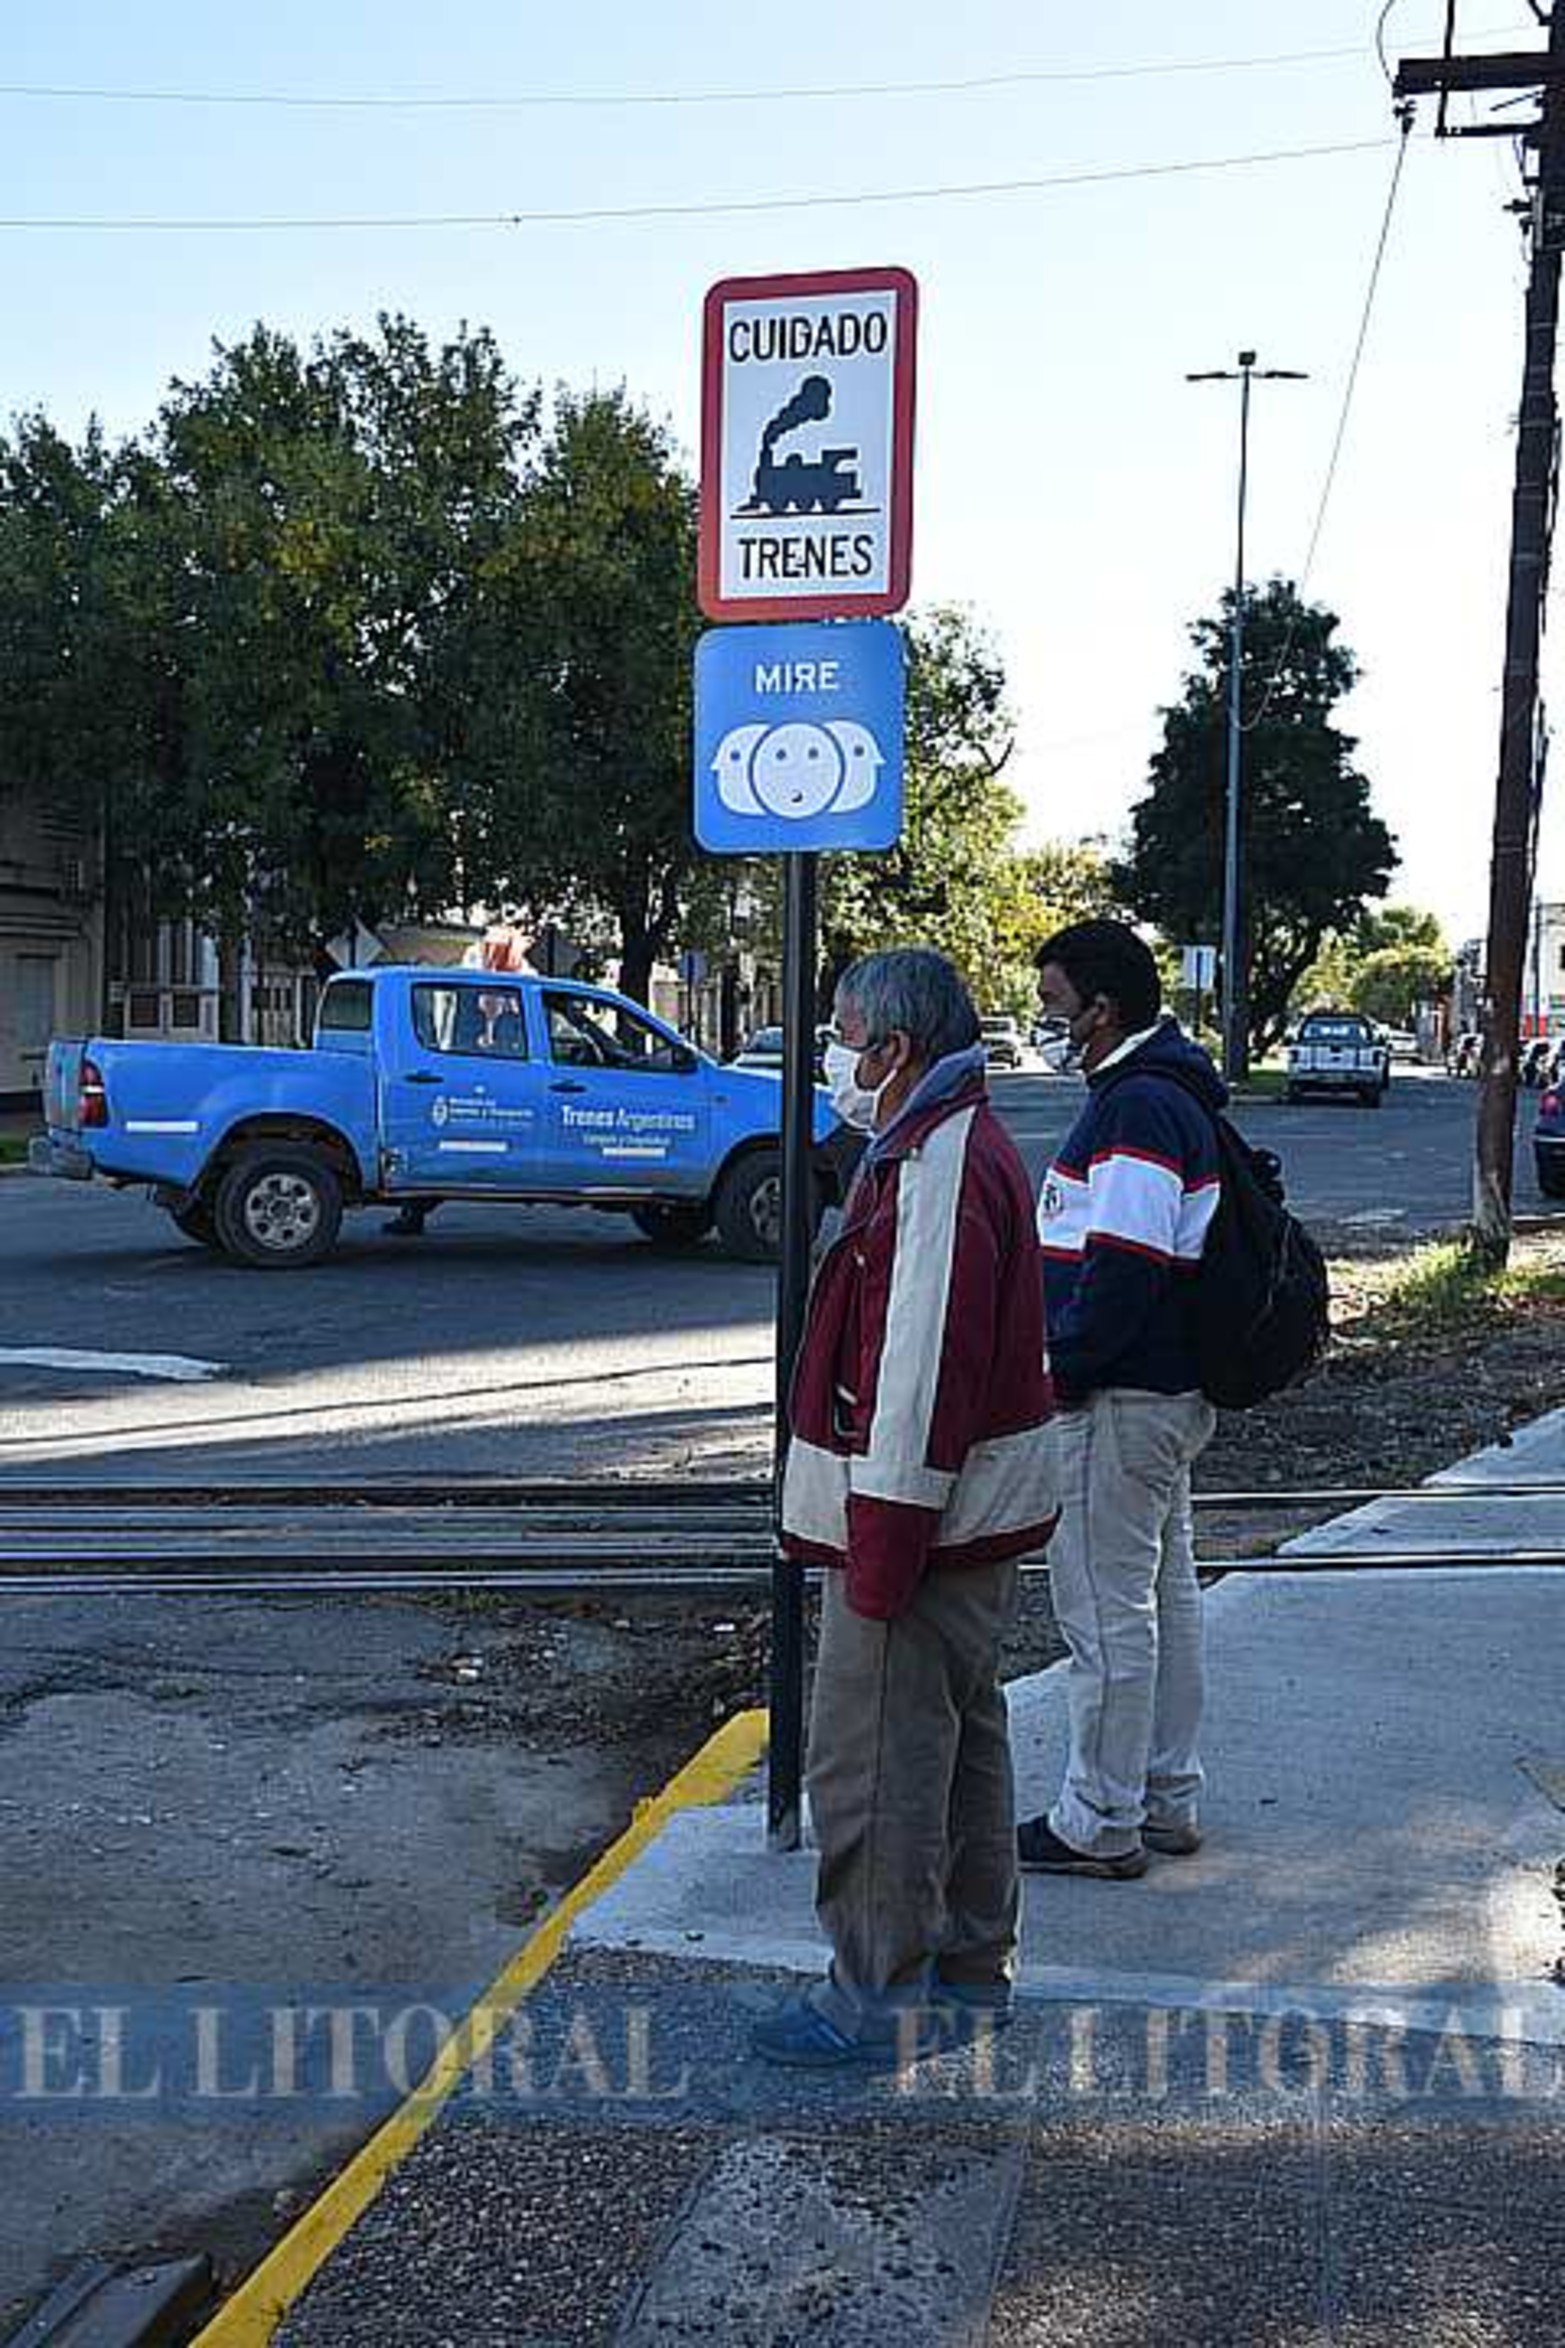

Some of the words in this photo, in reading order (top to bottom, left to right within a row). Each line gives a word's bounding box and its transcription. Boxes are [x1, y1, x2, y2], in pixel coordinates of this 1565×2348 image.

[729, 312, 887, 362] CUIDADO
[738, 534, 874, 578] TRENES
[756, 662, 838, 693] MIRE
[561, 1105, 613, 1126] Trenes
